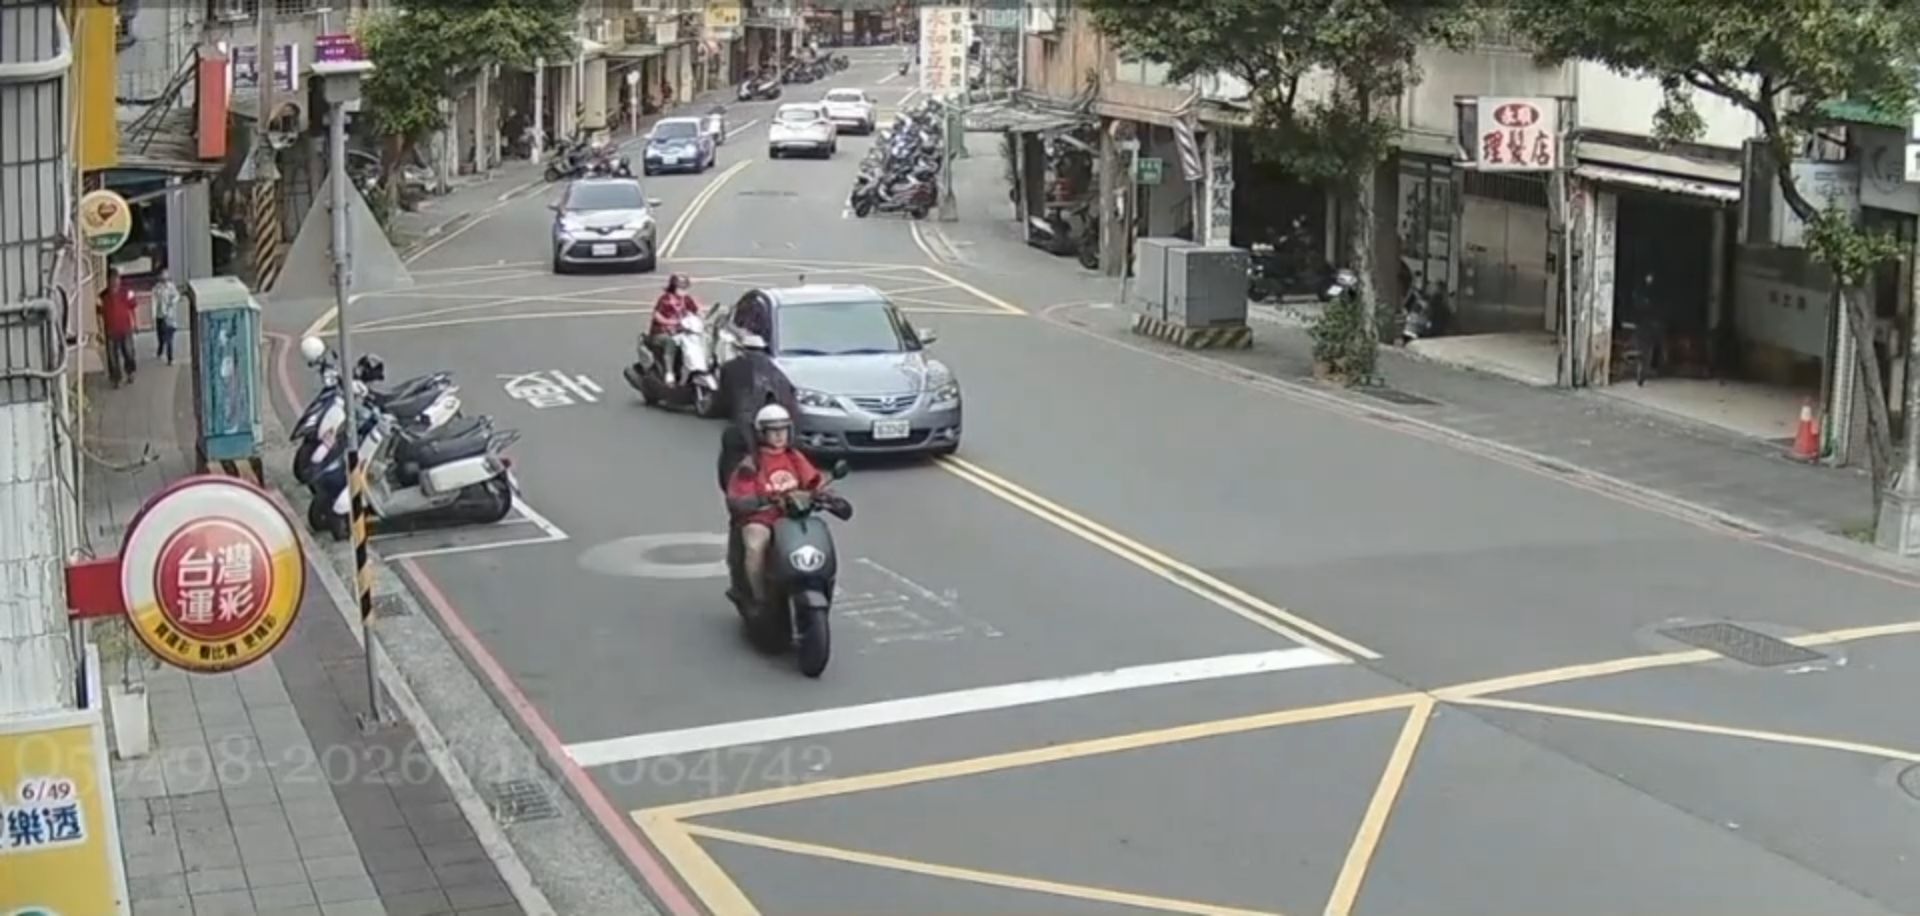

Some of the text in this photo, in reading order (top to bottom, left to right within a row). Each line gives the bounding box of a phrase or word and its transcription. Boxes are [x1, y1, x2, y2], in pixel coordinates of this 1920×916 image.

[1483, 129, 1550, 166] 理髮店
[178, 545, 253, 586] 台灣
[178, 589, 254, 624] 運彩
[21, 780, 71, 801] 6/49
[0, 803, 82, 848] 樂透
